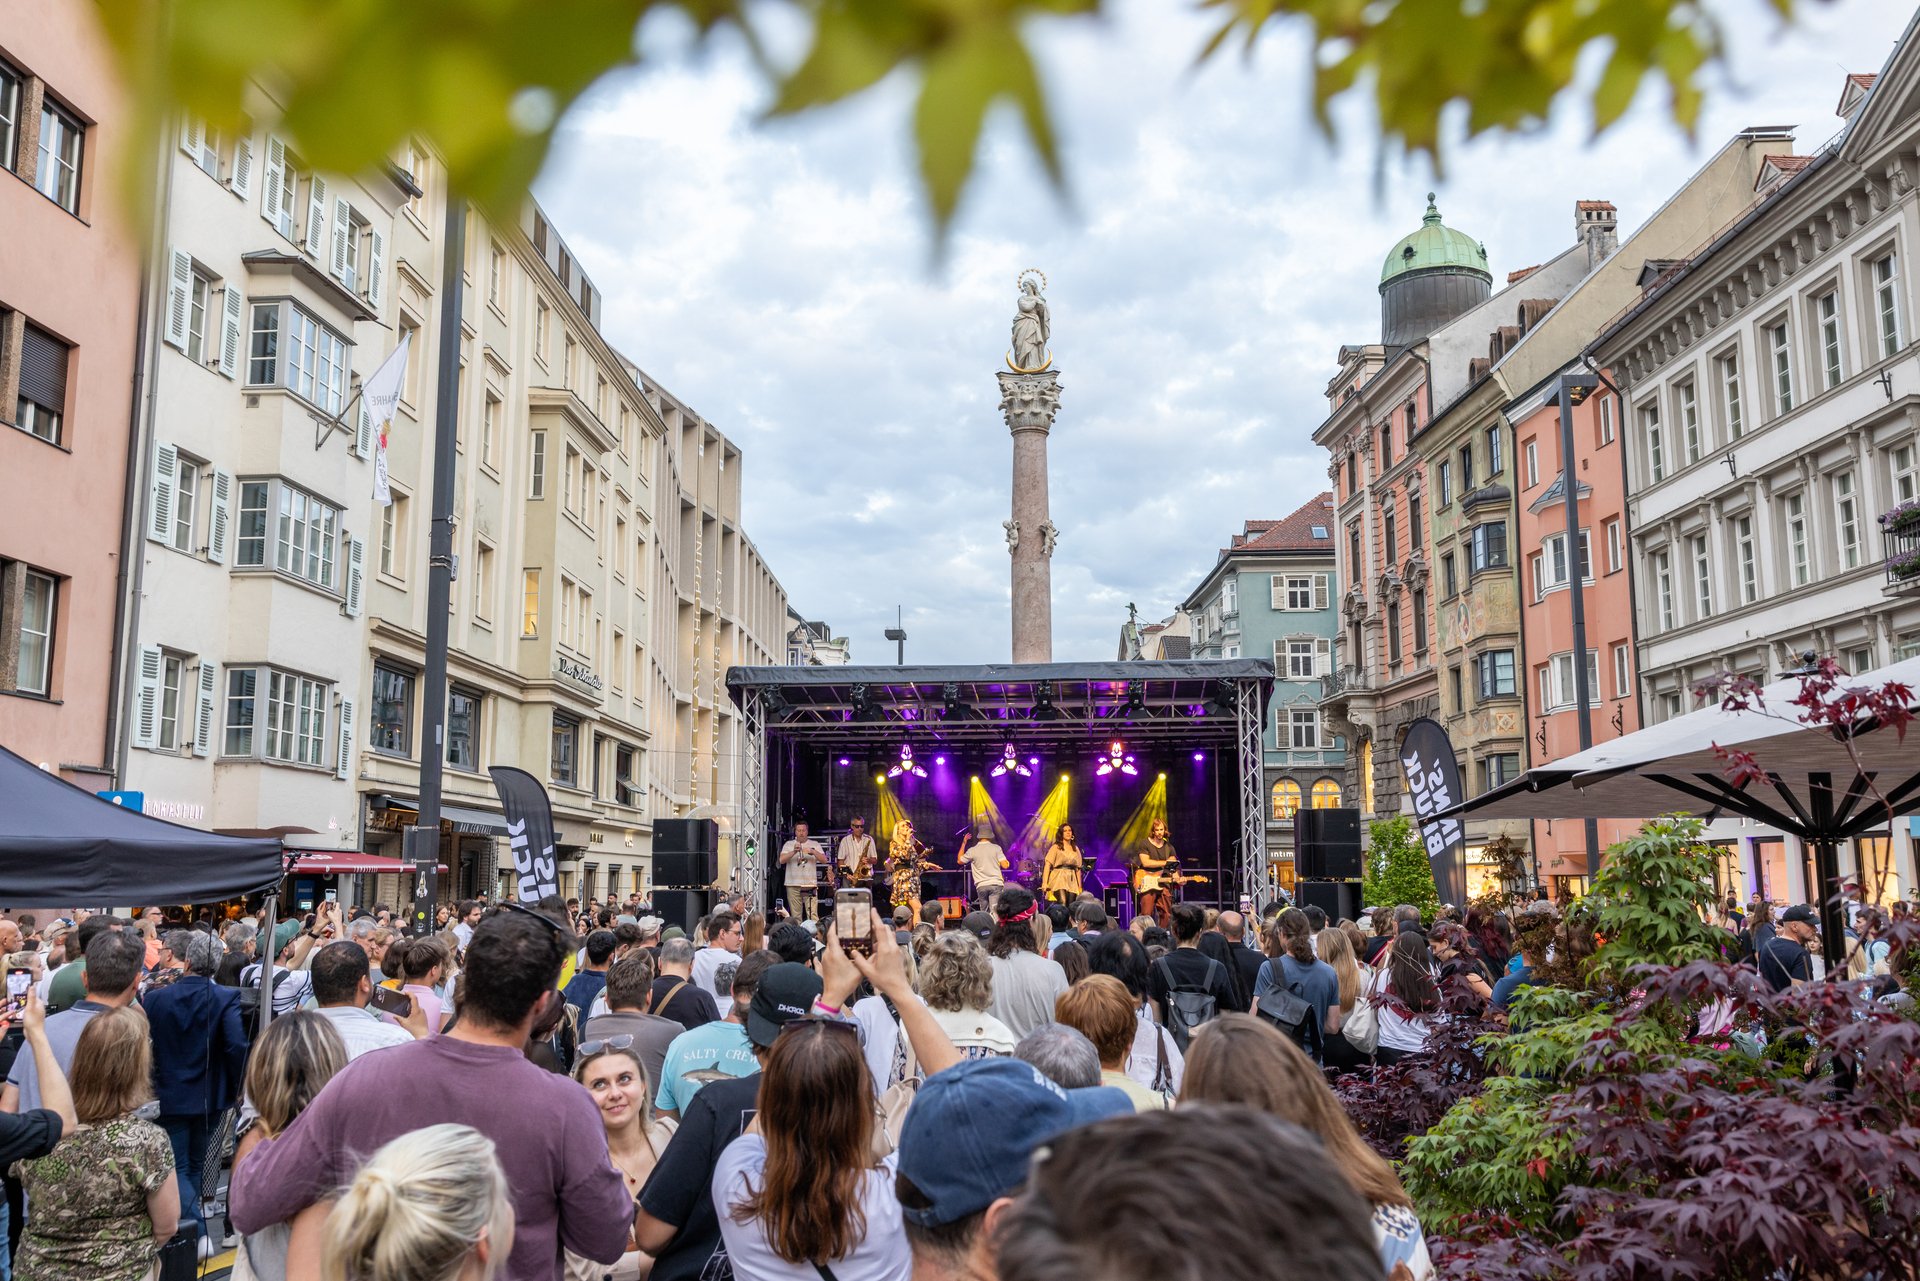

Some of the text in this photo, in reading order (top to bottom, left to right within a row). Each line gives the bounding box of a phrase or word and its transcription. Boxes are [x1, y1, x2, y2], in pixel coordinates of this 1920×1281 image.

[694, 520, 703, 647] SHOPPING
[713, 569, 723, 768] KAUFHAUS TYROL
[144, 800, 204, 820] TOMASELLI
[683, 1048, 719, 1062] SALTY
